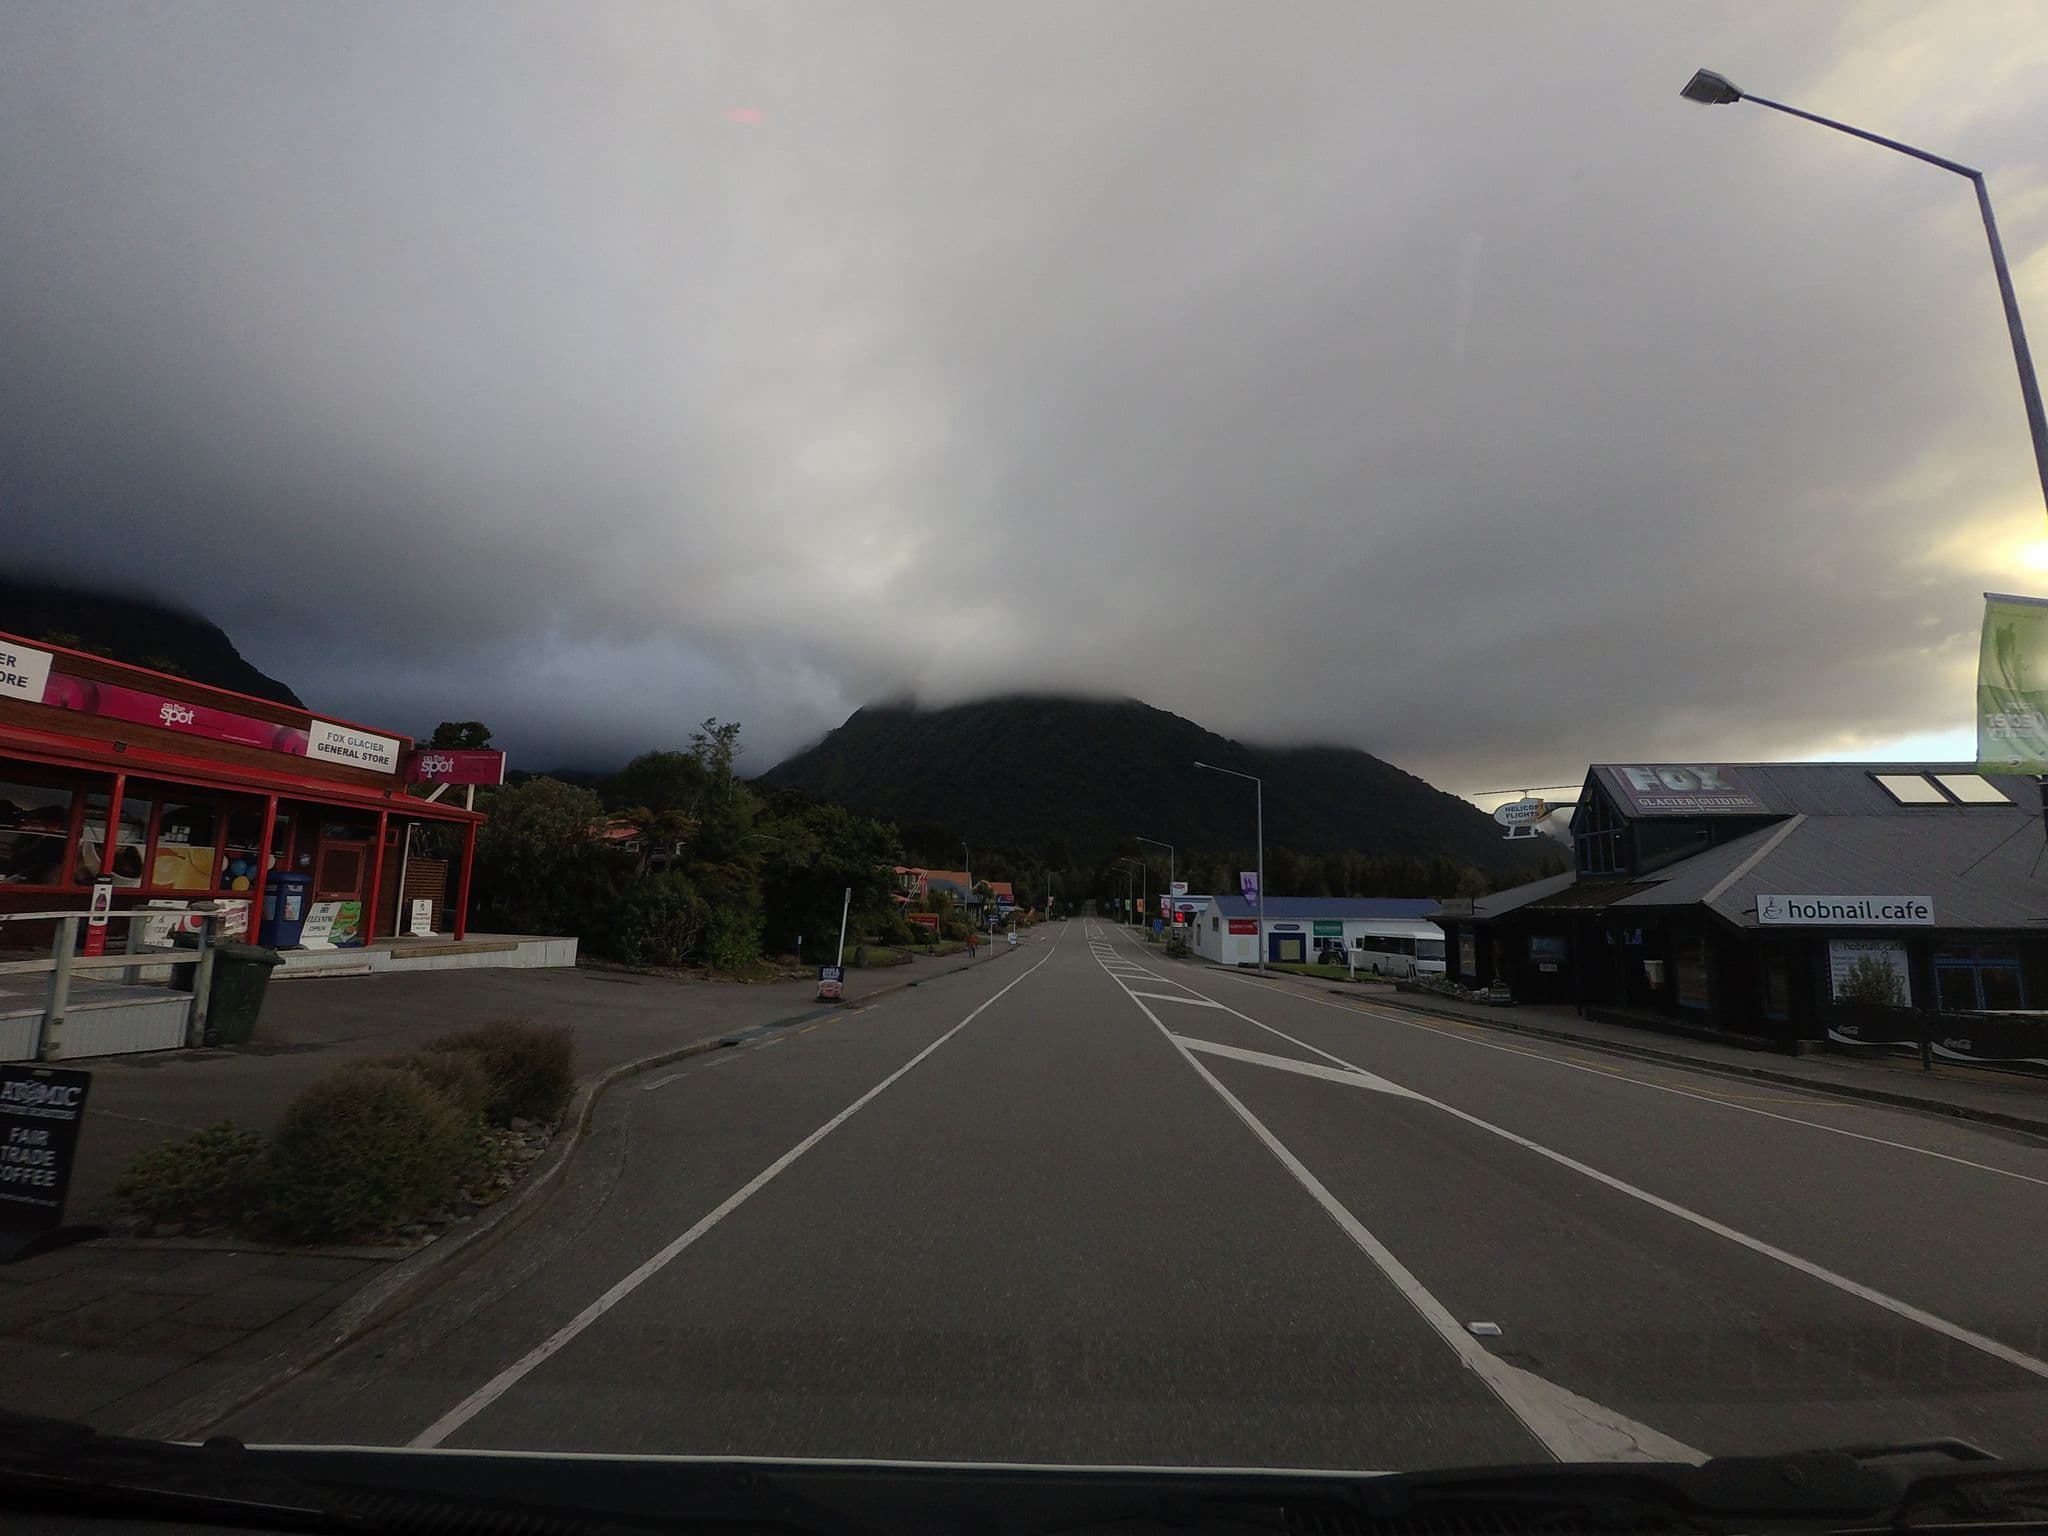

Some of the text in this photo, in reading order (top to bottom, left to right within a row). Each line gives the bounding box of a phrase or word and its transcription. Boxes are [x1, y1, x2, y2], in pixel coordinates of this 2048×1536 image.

[159, 708, 194, 727] spot
[327, 732, 384, 752] FOX GLACIER
[317, 742, 390, 766] GENERAL STORE
[420, 758, 455, 778] spot
[1621, 767, 1736, 792] FOX
[1638, 797, 1755, 807] GLACIER GUIDING
[1505, 811, 1540, 820] FLIGHTS
[1788, 900, 1929, 919] hobnail.cafe
